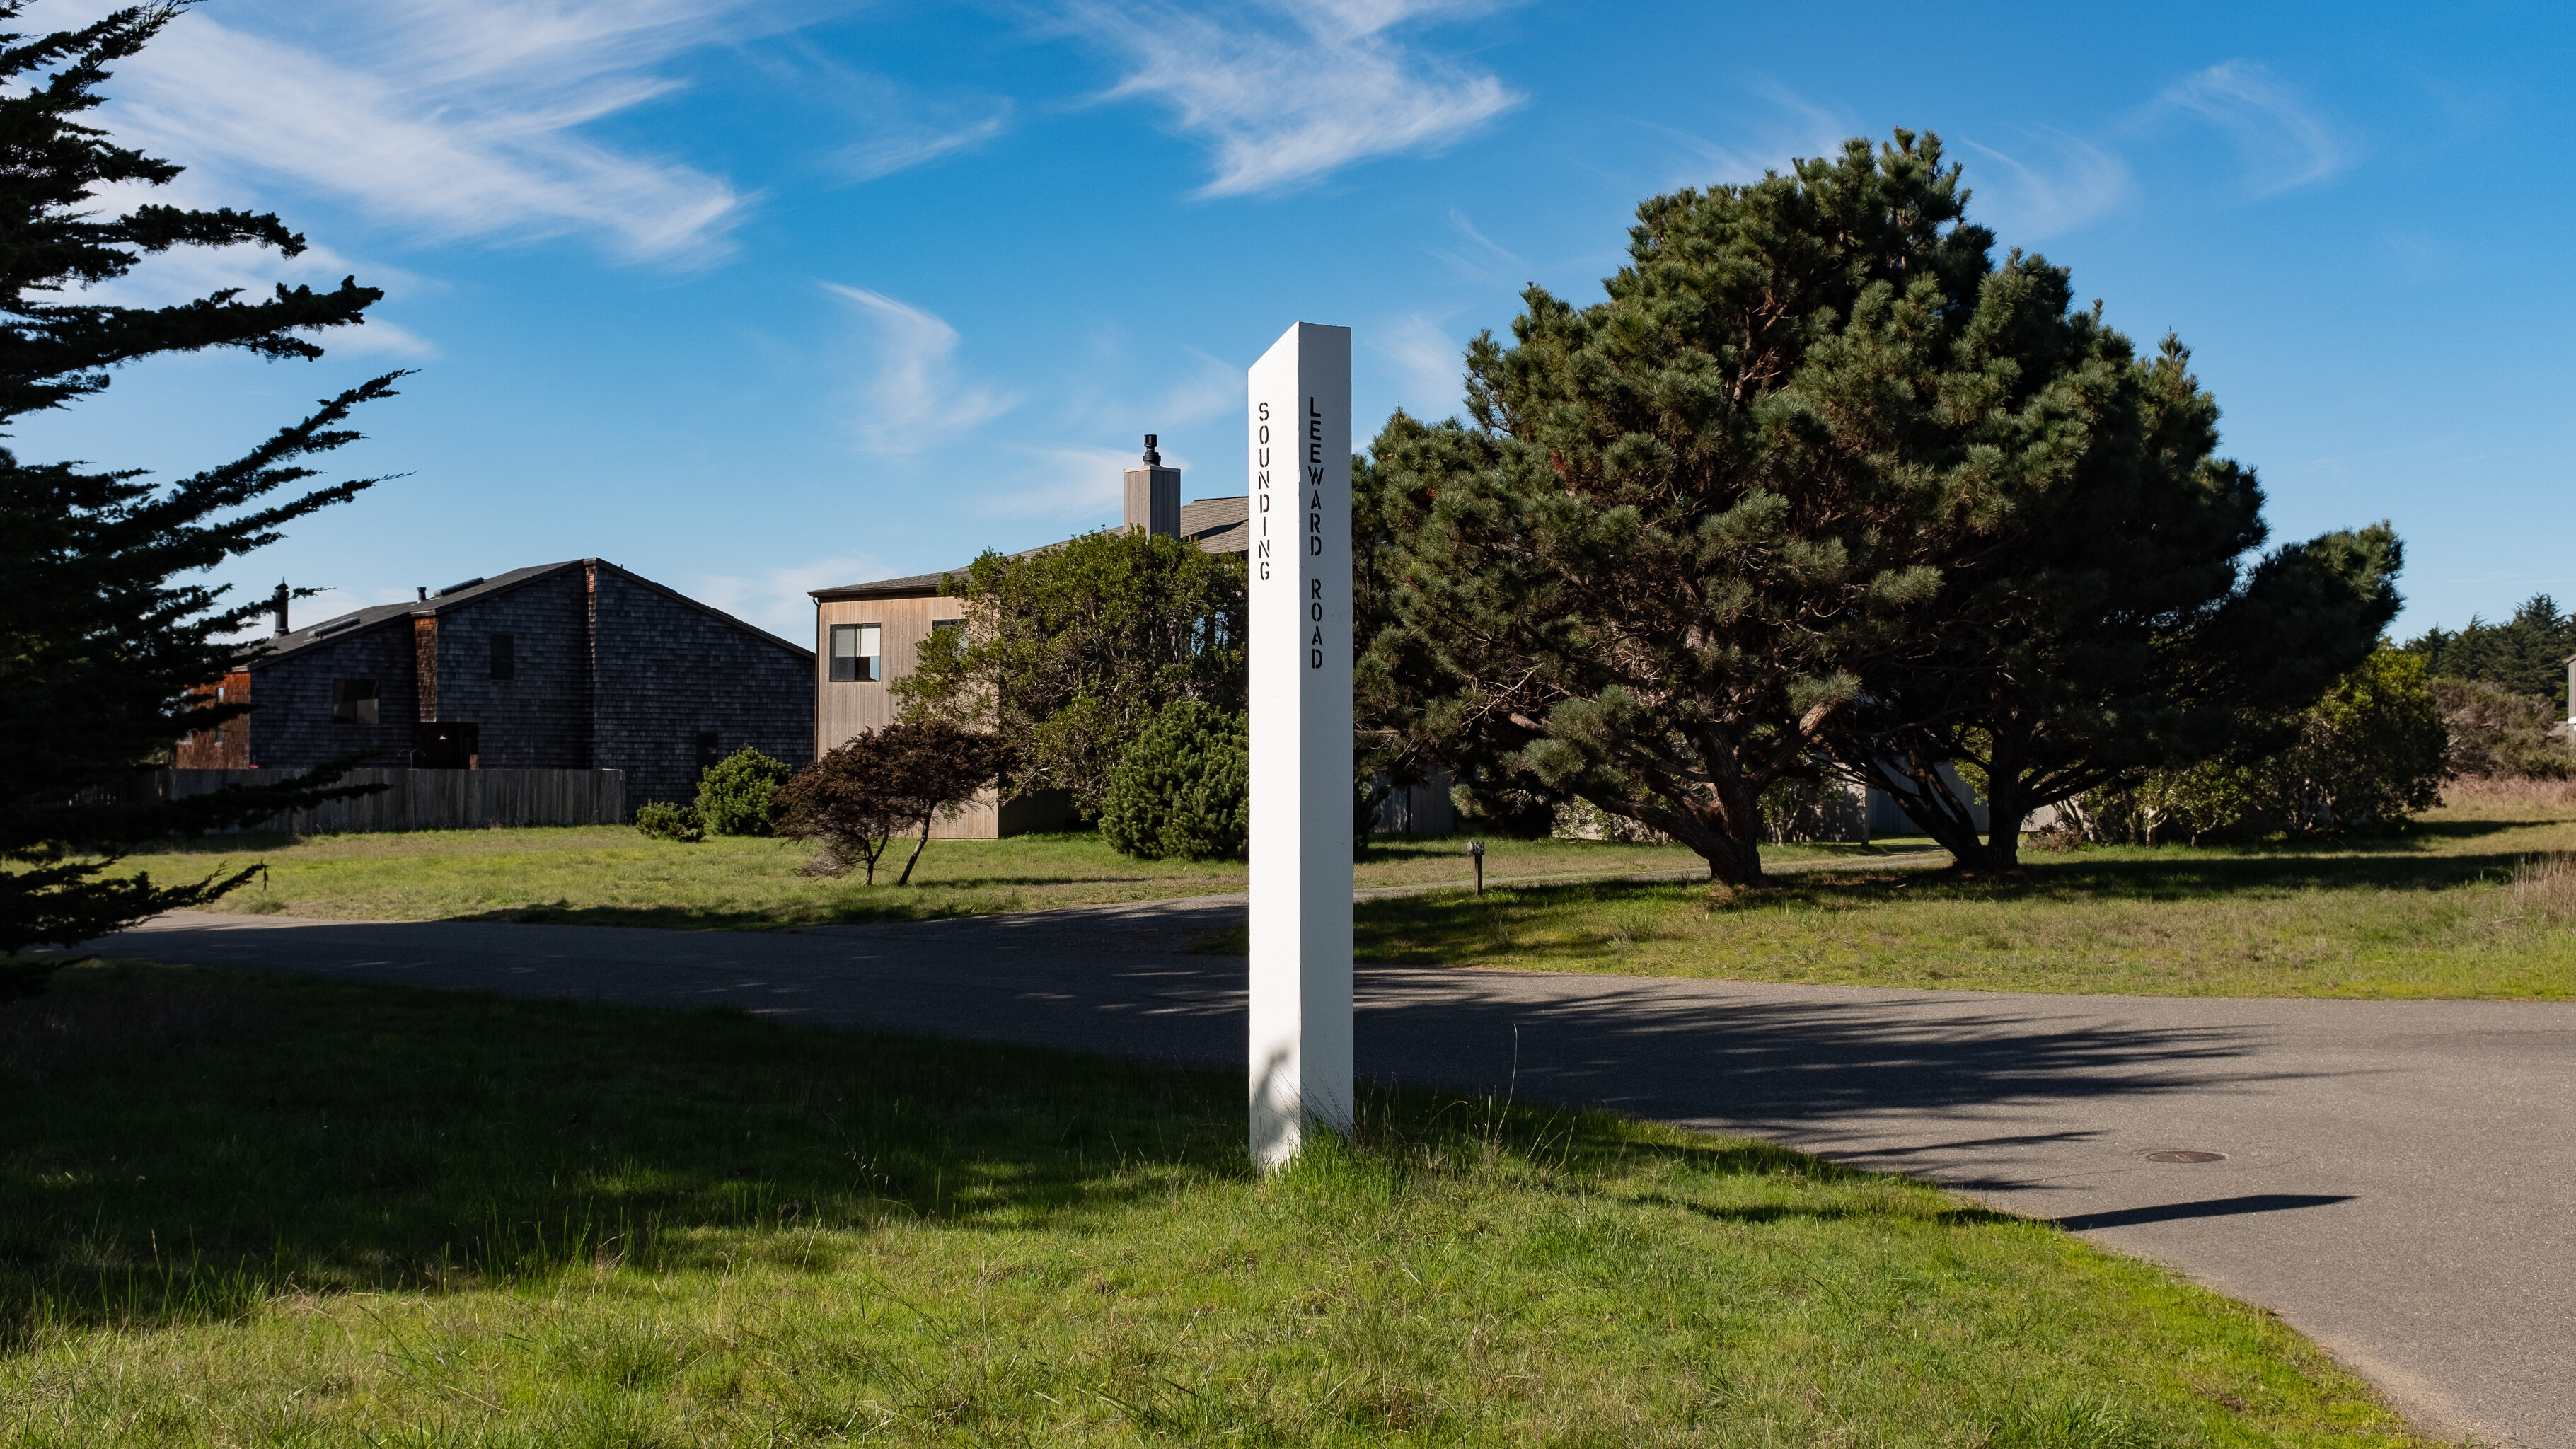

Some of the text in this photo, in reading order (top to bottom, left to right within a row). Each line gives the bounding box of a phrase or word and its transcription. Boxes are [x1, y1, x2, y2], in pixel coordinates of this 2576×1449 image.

[1258, 402, 1270, 581] SOUNDING
[1307, 396, 1324, 669] LEEWARD ROAD
